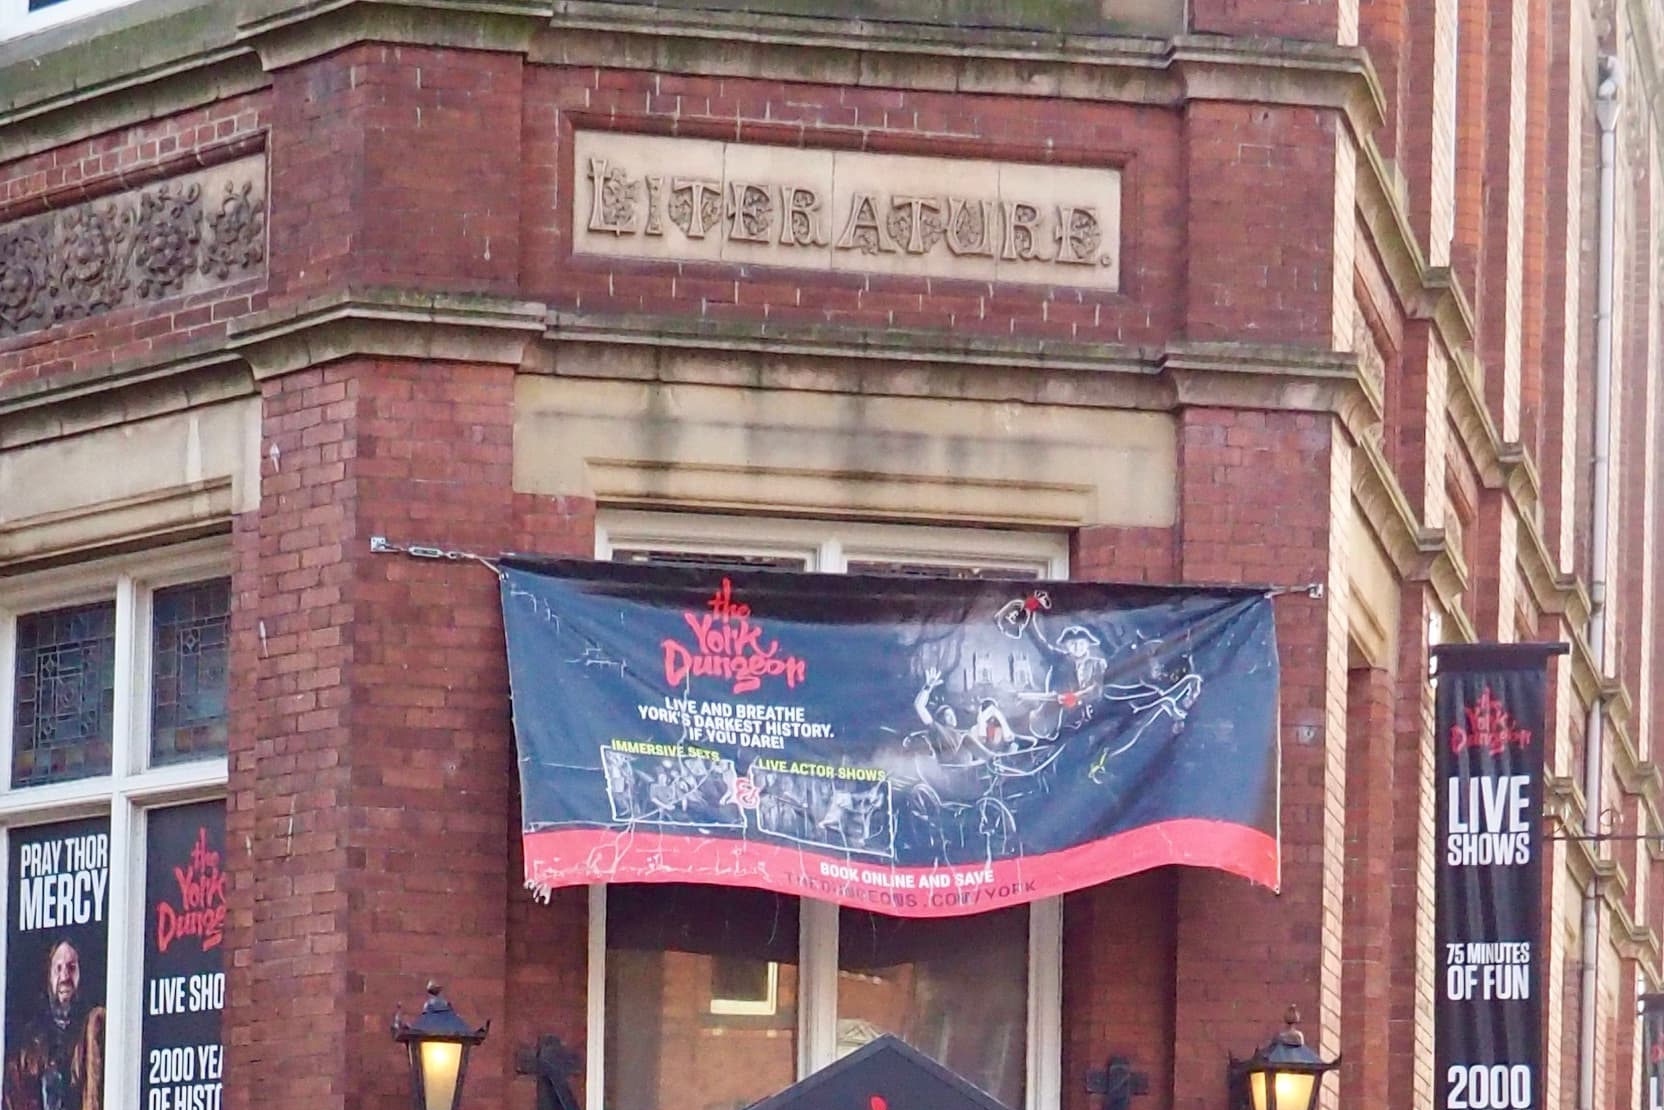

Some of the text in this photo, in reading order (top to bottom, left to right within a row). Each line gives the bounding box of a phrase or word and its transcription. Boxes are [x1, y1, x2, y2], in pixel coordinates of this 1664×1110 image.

[708, 577, 750, 623] the
[684, 612, 778, 657] York
[661, 639, 805, 694] Dungeon
[638, 705, 835, 738] YORK'S DARKEST HISTORY.
[665, 696, 805, 722] LIVE AND BREATHE
[612, 739, 720, 762] IMMERSIVE SETS
[689, 728, 784, 749] IF YOU DARE!
[759, 758, 788, 773] LIVE
[791, 761, 833, 777] ACTOR
[1449, 775, 1530, 833] LIVE
[21, 833, 108, 878] PRAY THOR
[191, 827, 221, 873] the
[1448, 832, 1530, 866] SHOWS
[820, 861, 994, 889] BOOK ONLINE AND SAVE
[19, 868, 108, 931] MERCY
[1446, 942, 1530, 965] 75 MINUTES
[150, 976, 186, 1015] LIVE
[1447, 964, 1529, 1000] OF FUN
[148, 1047, 194, 1084] 2000
[1447, 1065, 1531, 1109] 2000
